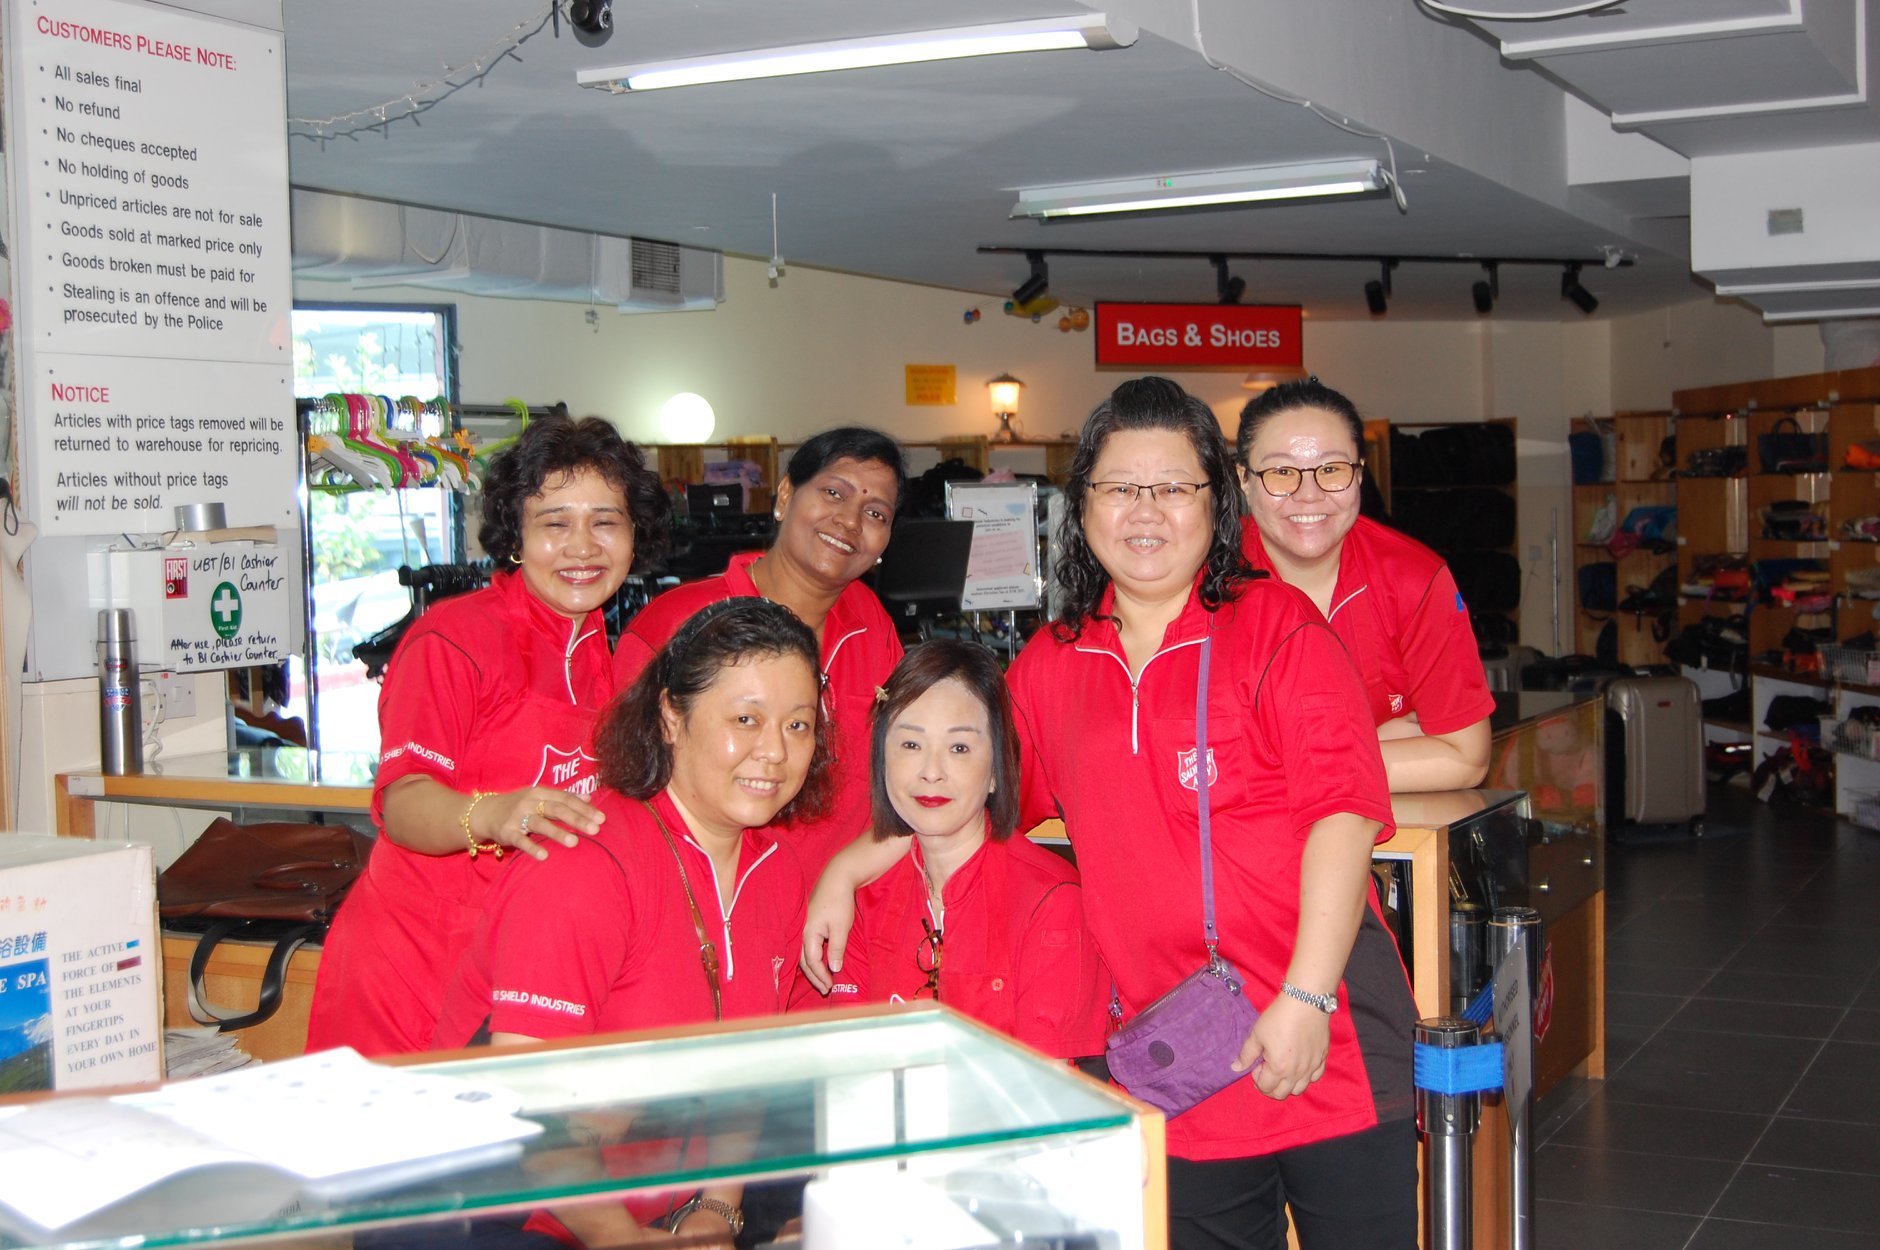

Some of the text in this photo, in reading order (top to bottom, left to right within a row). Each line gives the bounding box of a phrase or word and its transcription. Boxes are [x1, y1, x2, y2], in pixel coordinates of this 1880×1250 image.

[37, 15, 237, 71] CUSTOMERS PLEASE NOTE:
[54, 65, 142, 93] All sales final
[55, 96, 120, 120] No refund
[57, 127, 197, 162] No cheques accepted
[58, 158, 189, 190] No holding of goods
[60, 190, 262, 228] Unpriced articles are not for sale
[61, 221, 262, 258] Goods sold at marked price only
[62, 252, 256, 284] Goods broken must be paid for
[64, 283, 268, 312] Stealing is an offence and will be
[64, 306, 224, 331] prosecuted by the Police
[1117, 322, 1280, 348] BAGS & SHOES
[52, 383, 110, 403] NOTICE
[54, 412, 284, 432] Articles with price tags removed will be
[54, 436, 282, 455] returned to warehouse for repricing.
[57, 472, 228, 490] Articles without price tags
[57, 494, 162, 512] will not be sold.
[166, 560, 187, 580] FIRST
[241, 554, 278, 570] Cashier
[240, 570, 284, 592] Counter
[170, 638, 192, 650] After
[216, 636, 242, 650] please
[248, 630, 277, 645] return
[182, 653, 194, 665] to
[210, 651, 242, 664] Cashier
[408, 742, 455, 770] INDUSTRIES
[1184, 752, 1198, 768] THE
[552, 757, 580, 785] THE
[62, 942, 124, 963] THE ACTIVE
[17, 970, 47, 990] SPA
[62, 962, 115, 982] FORCE OF
[64, 974, 142, 1000] THE ELEMENTS
[65, 999, 112, 1018] AT YOUR
[500, 990, 530, 1003] SHIELD
[531, 994, 586, 1016] INDUSTRIES
[66, 1015, 124, 1037] FINGERTIPS
[67, 1027, 140, 1056] EVERY DAY IN
[68, 1041, 158, 1073] YOUR OWN HOME
